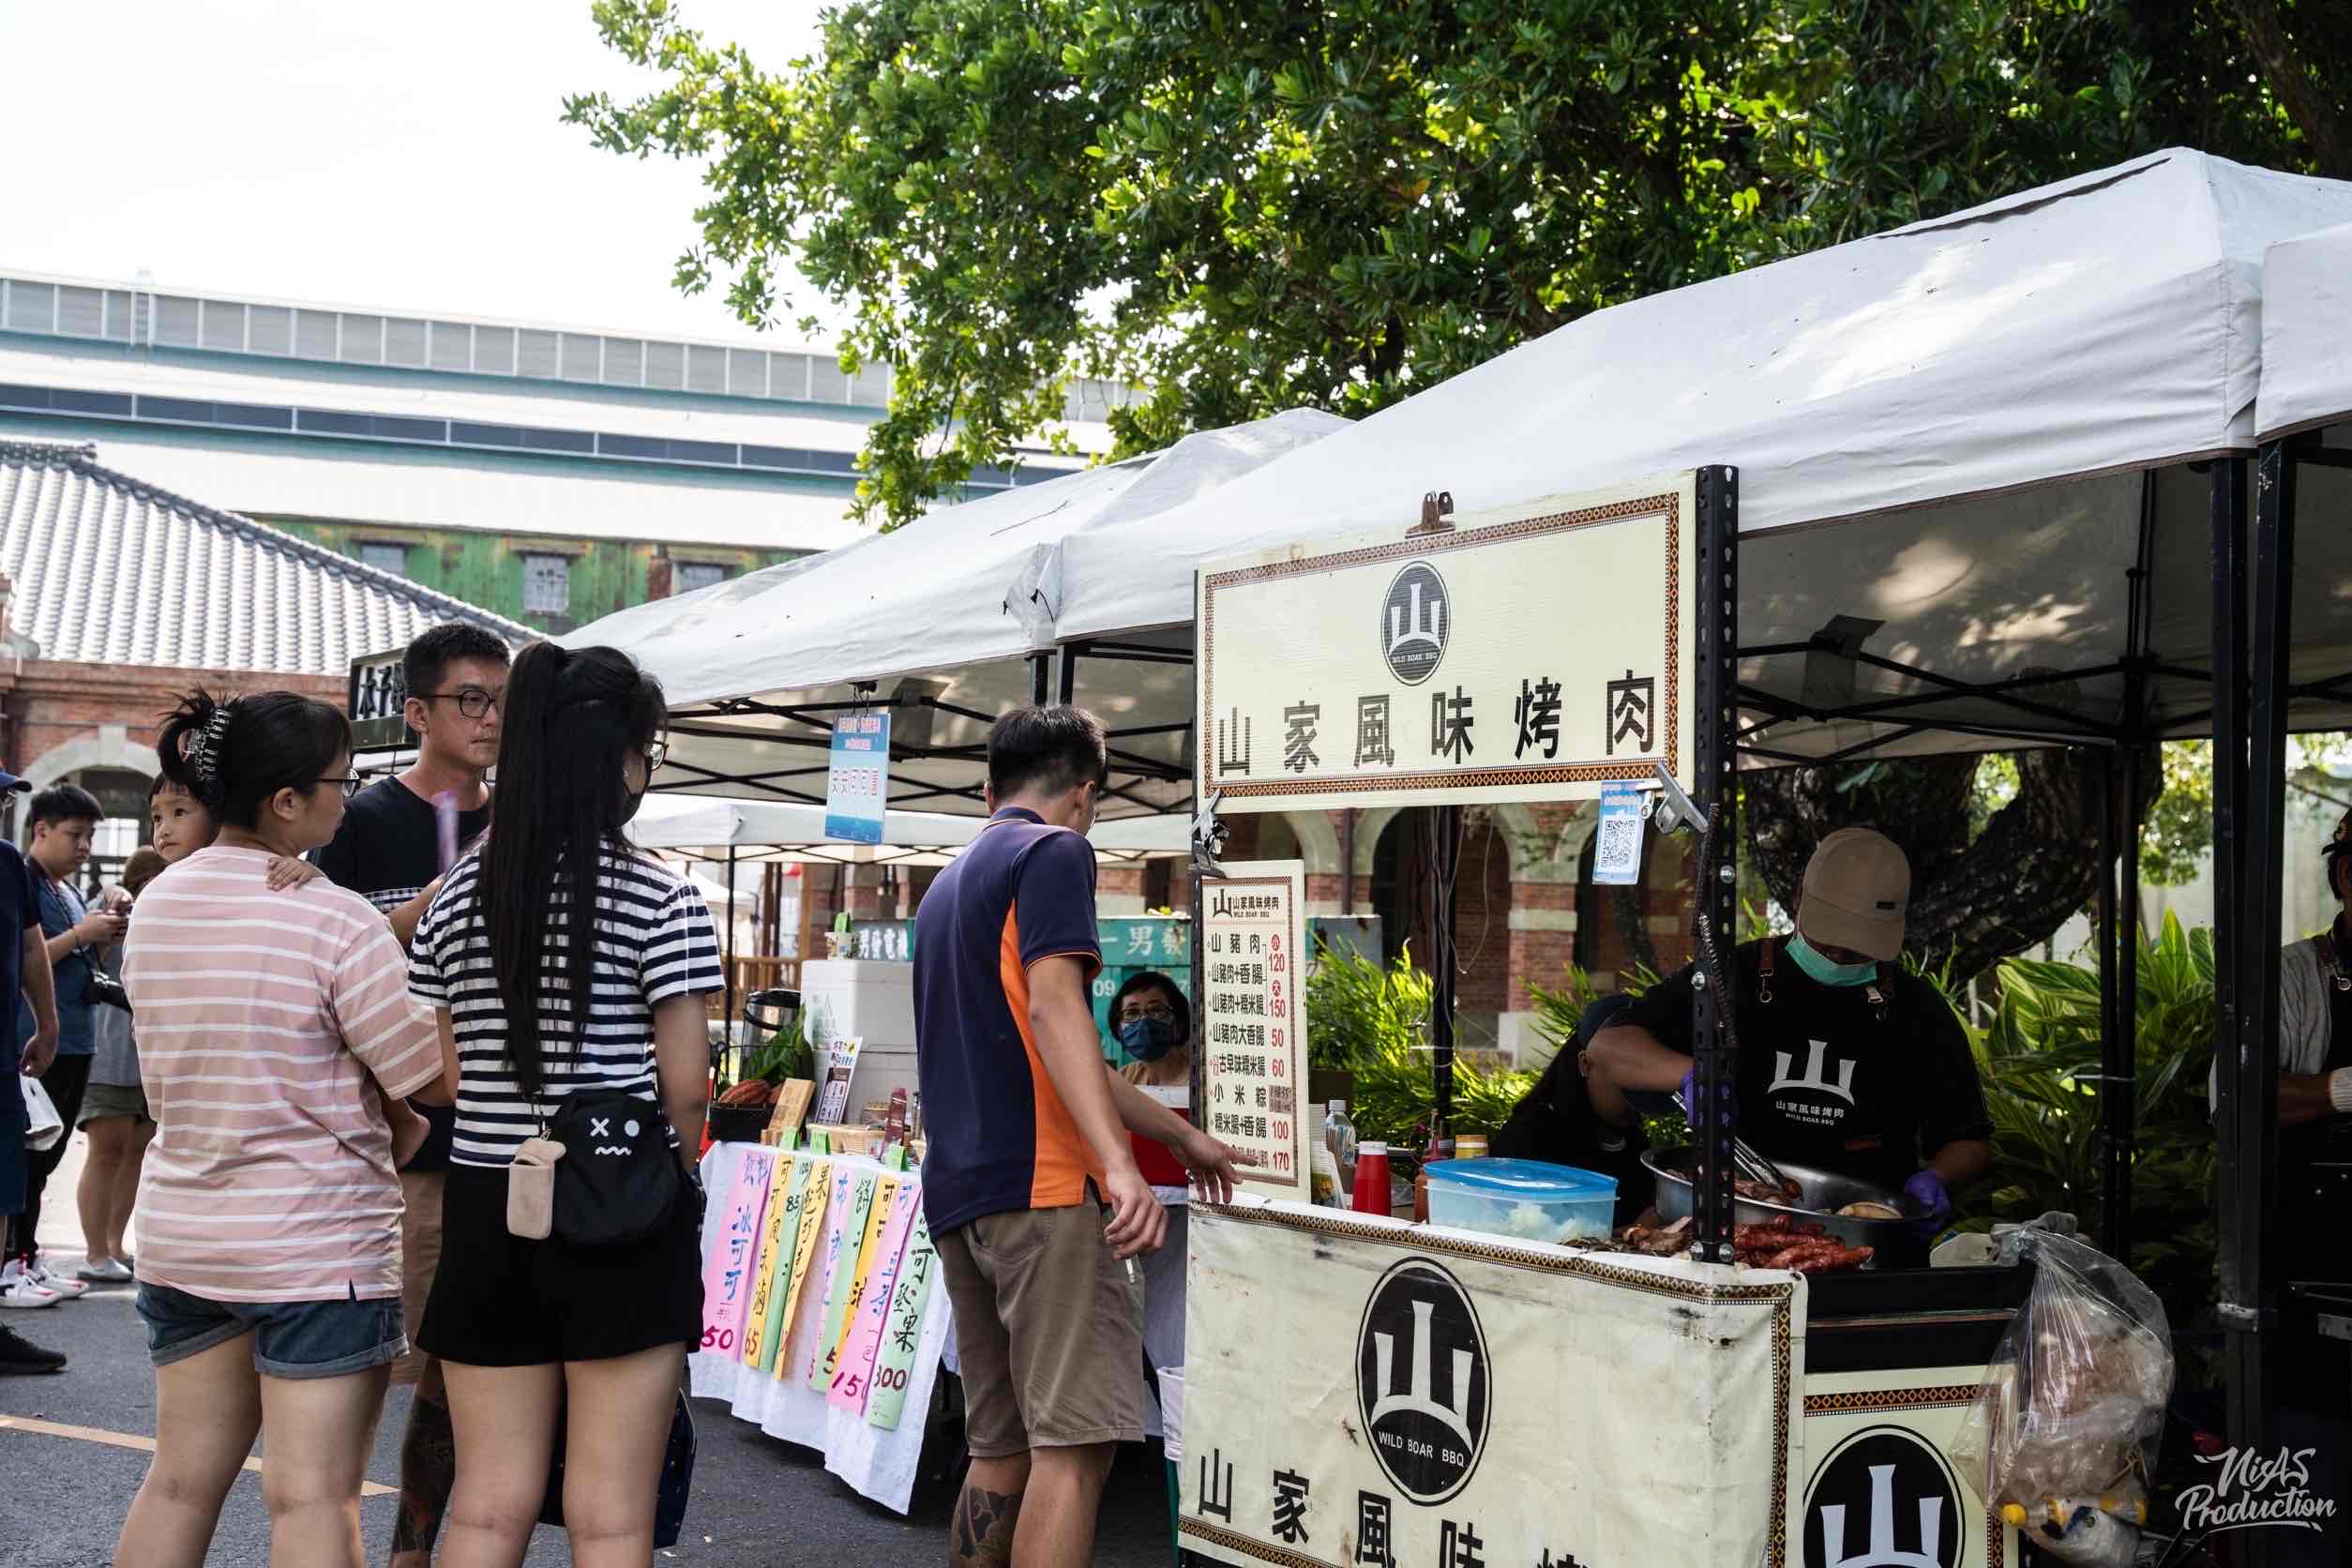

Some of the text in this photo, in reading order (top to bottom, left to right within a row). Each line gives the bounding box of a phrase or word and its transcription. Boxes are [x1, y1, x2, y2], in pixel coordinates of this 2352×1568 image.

[1218, 668, 1656, 776] 山家風味烤肉
[1232, 896, 1279, 910] 山家風味烤肉
[1211, 932, 1260, 955] 山豬肉
[1212, 962, 1263, 985] 山豬肉+香腸
[1269, 954, 1286, 972] 120
[1212, 992, 1264, 1016] 山豬肉+糯米腸
[1269, 999, 1286, 1018] 150
[1213, 1021, 1284, 1048] 山豬肉大香腸 50
[1219, 1053, 1266, 1077] 古早味糯米腸
[1272, 1059, 1285, 1078] 60
[1214, 1083, 1267, 1108] 小米粽
[1775, 1099, 1845, 1118] 山家風味烤肉
[1214, 1113, 1289, 1140] 糯米腸+香腸 100
[1273, 1151, 1289, 1171] 170
[1378, 1430, 1466, 1470] WILD BOAR BBQ
[1198, 1448, 1590, 1568] 山家風味
